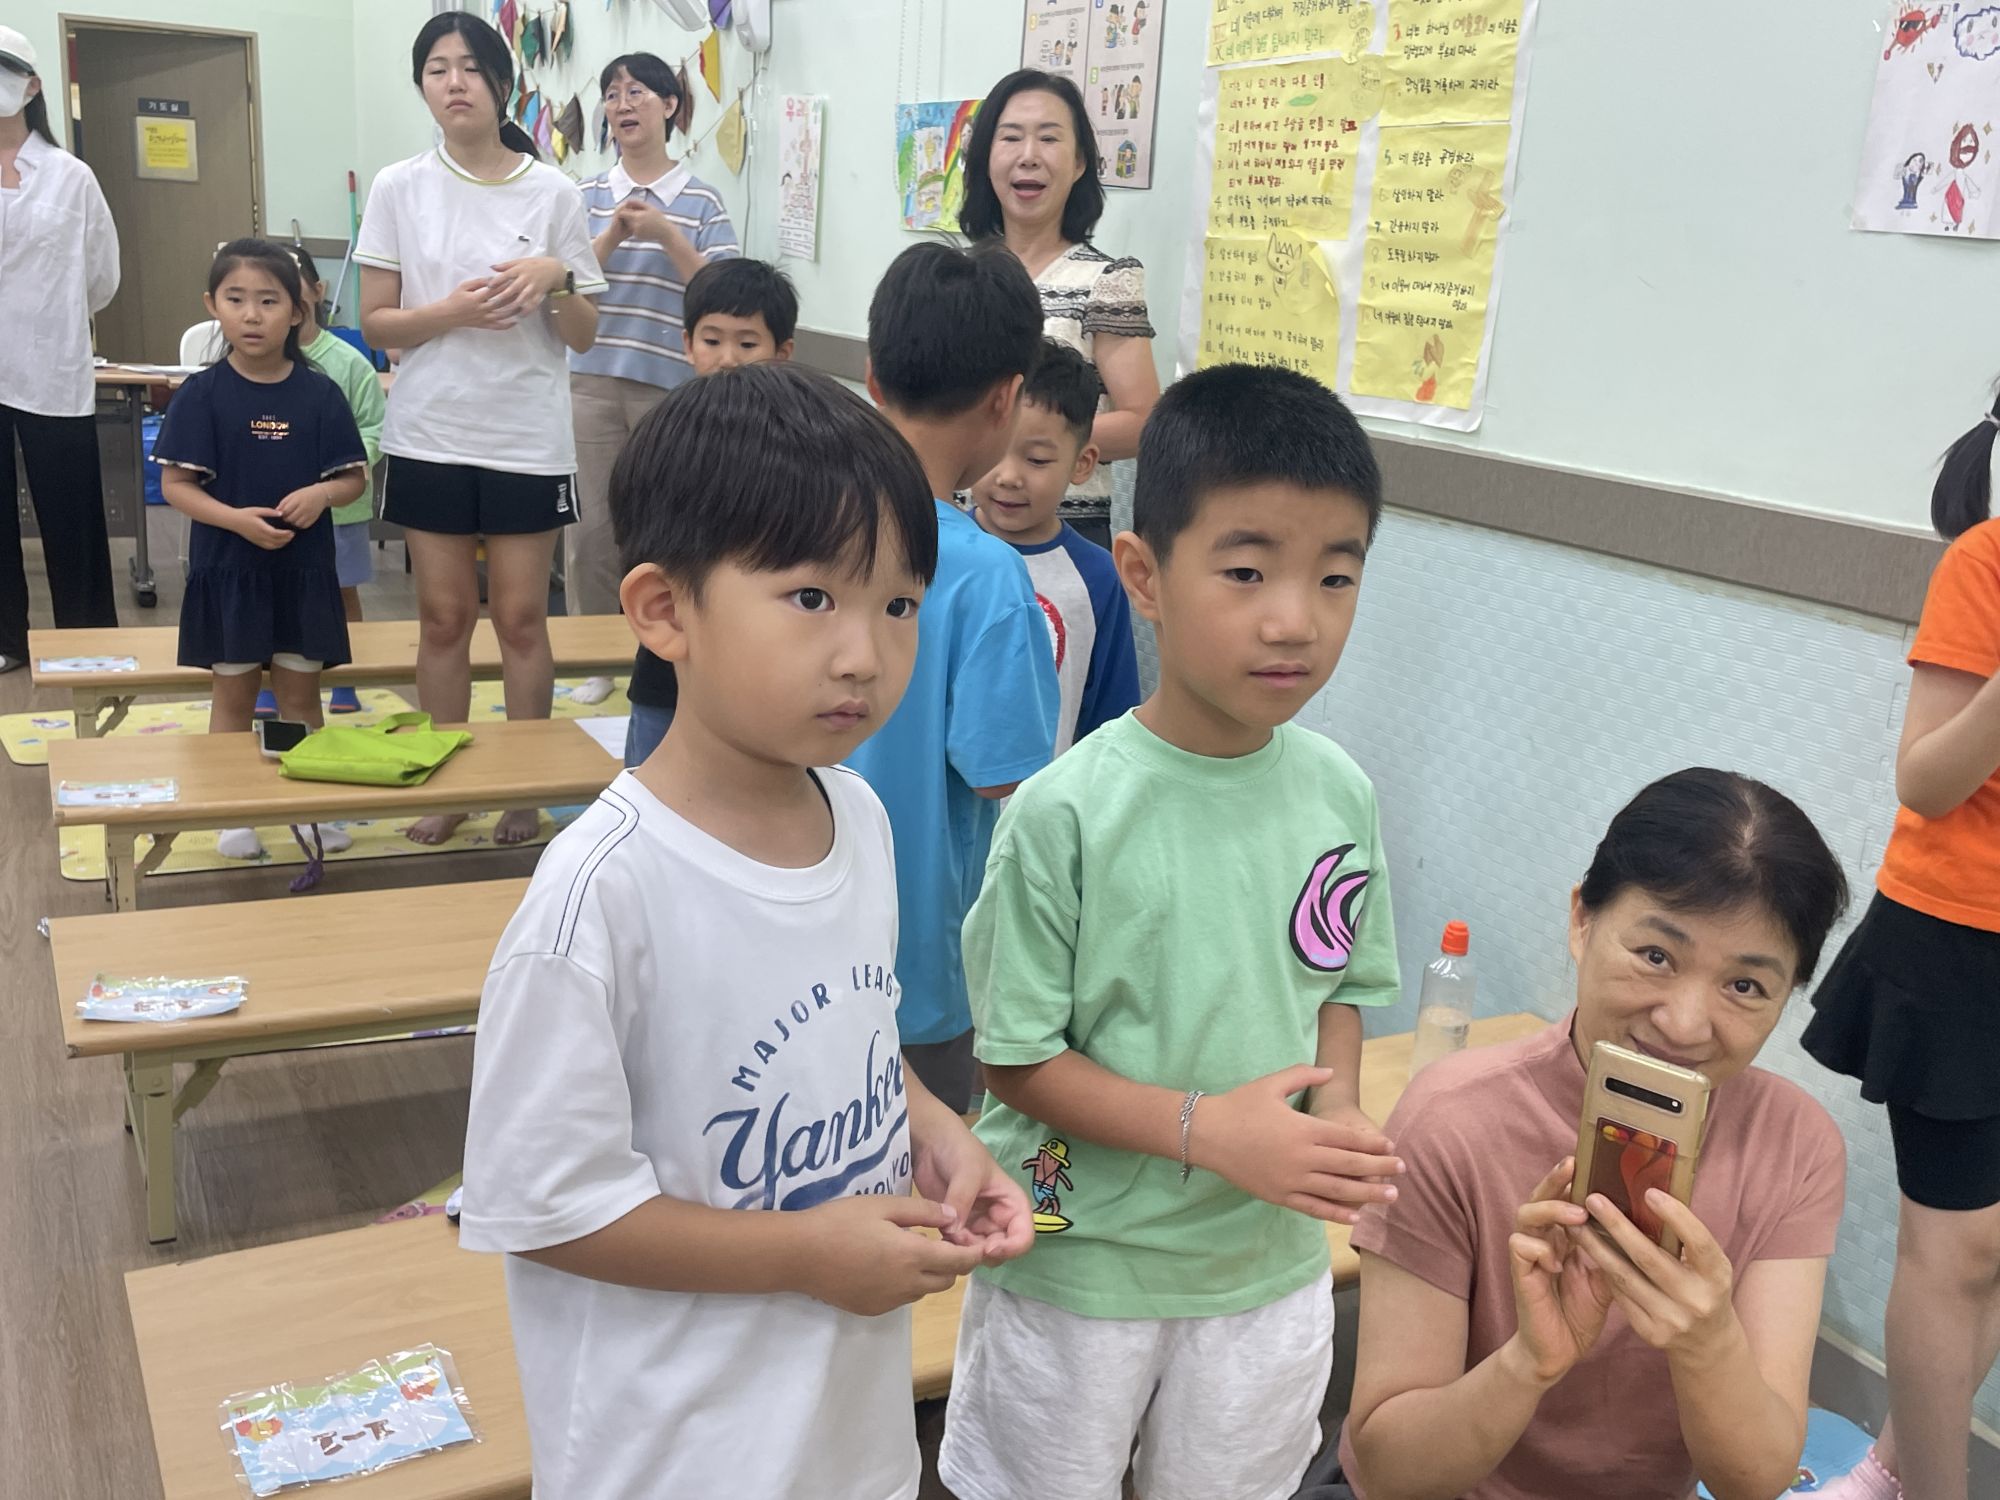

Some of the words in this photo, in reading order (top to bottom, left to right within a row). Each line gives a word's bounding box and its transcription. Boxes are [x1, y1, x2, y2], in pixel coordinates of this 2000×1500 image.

[731, 982, 832, 1092] MAJOR
[852, 964, 894, 998] LEAG
[702, 1029, 905, 1210] Yankee
